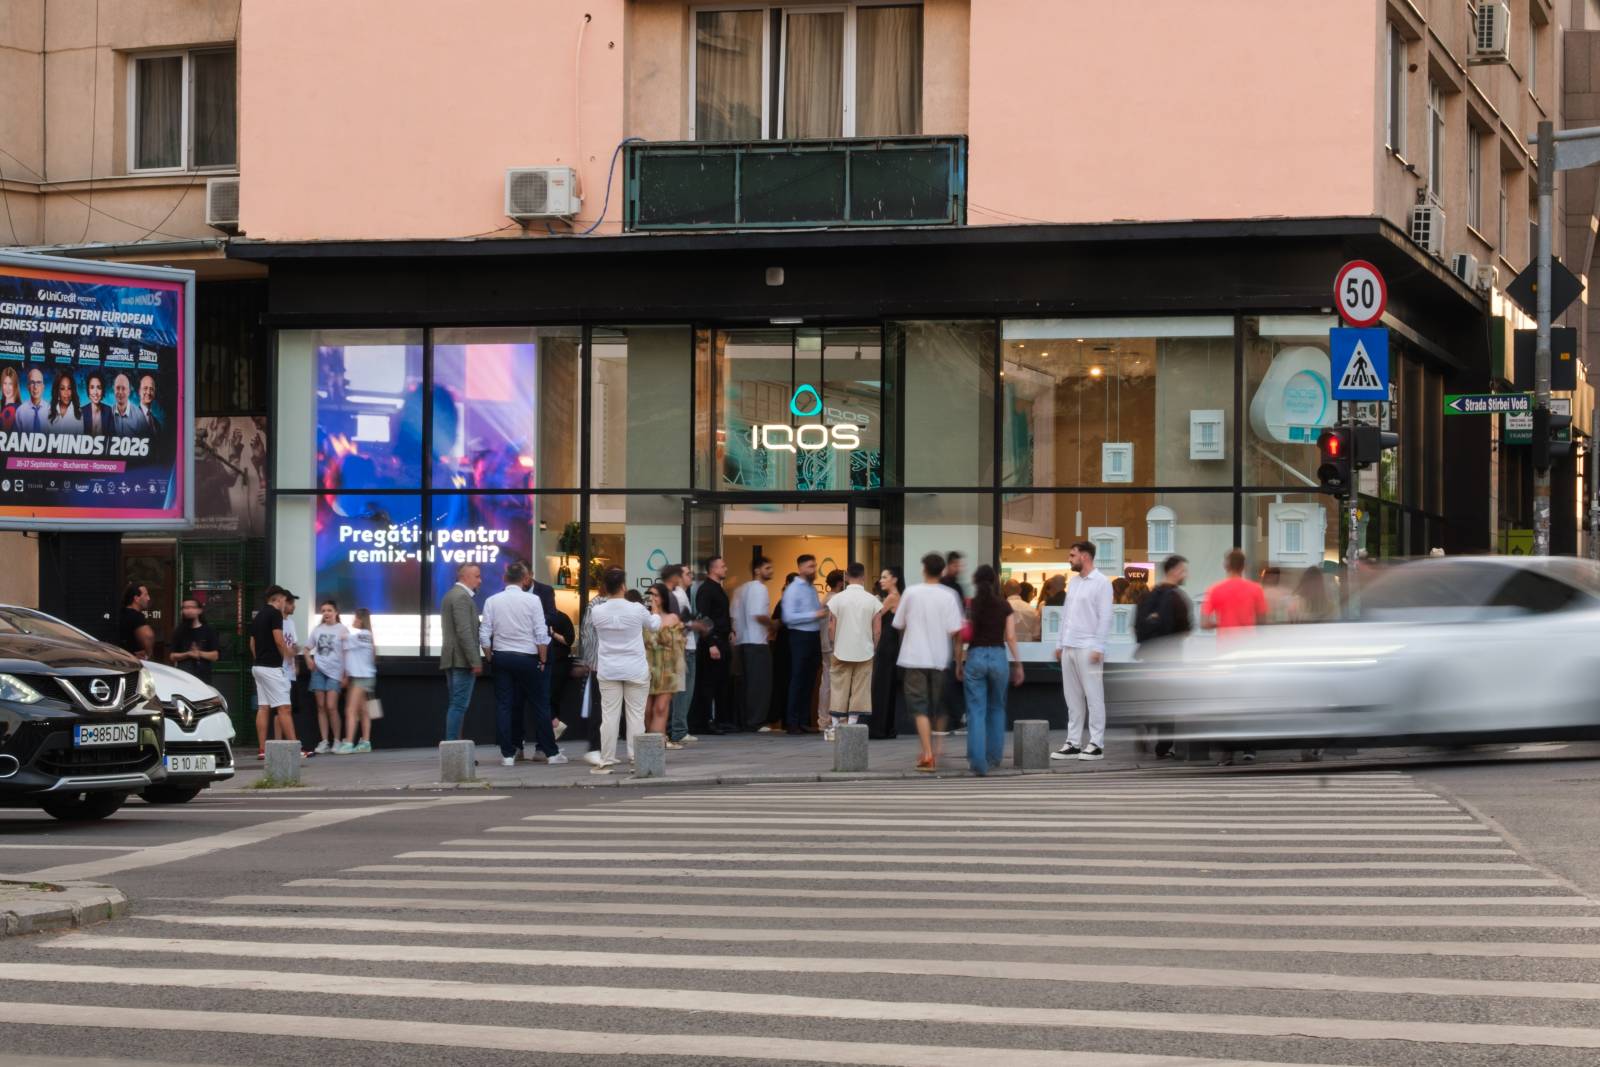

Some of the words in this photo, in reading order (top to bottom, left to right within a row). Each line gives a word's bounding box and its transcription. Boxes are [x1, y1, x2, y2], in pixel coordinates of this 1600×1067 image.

[46, 291, 76, 303] UniCredit
[1346, 278, 1374, 308] 50
[0, 302, 45, 316] CENTRAL
[47, 306, 54, 317] &
[55, 307, 100, 321] EASTERN
[101, 311, 153, 325] EUROPEAN
[39, 321, 79, 335] SUMMIT
[80, 324, 93, 335] OF
[95, 327, 115, 337] THE
[116, 328, 142, 339] YEAR
[1465, 398, 1487, 411] Strada
[109, 436, 149, 456] 2026
[752, 423, 860, 454] IQOS
[30, 461, 59, 469] September
[63, 461, 88, 469] Bucharest
[437, 525, 509, 547] pentru
[441, 545, 499, 563] verii?
[81, 728, 89, 743] B
[93, 727, 112, 742] 985
[113, 725, 136, 741] DNS
[171, 757, 179, 770] B
[182, 757, 191, 770] 10
[194, 757, 208, 770] AIR
